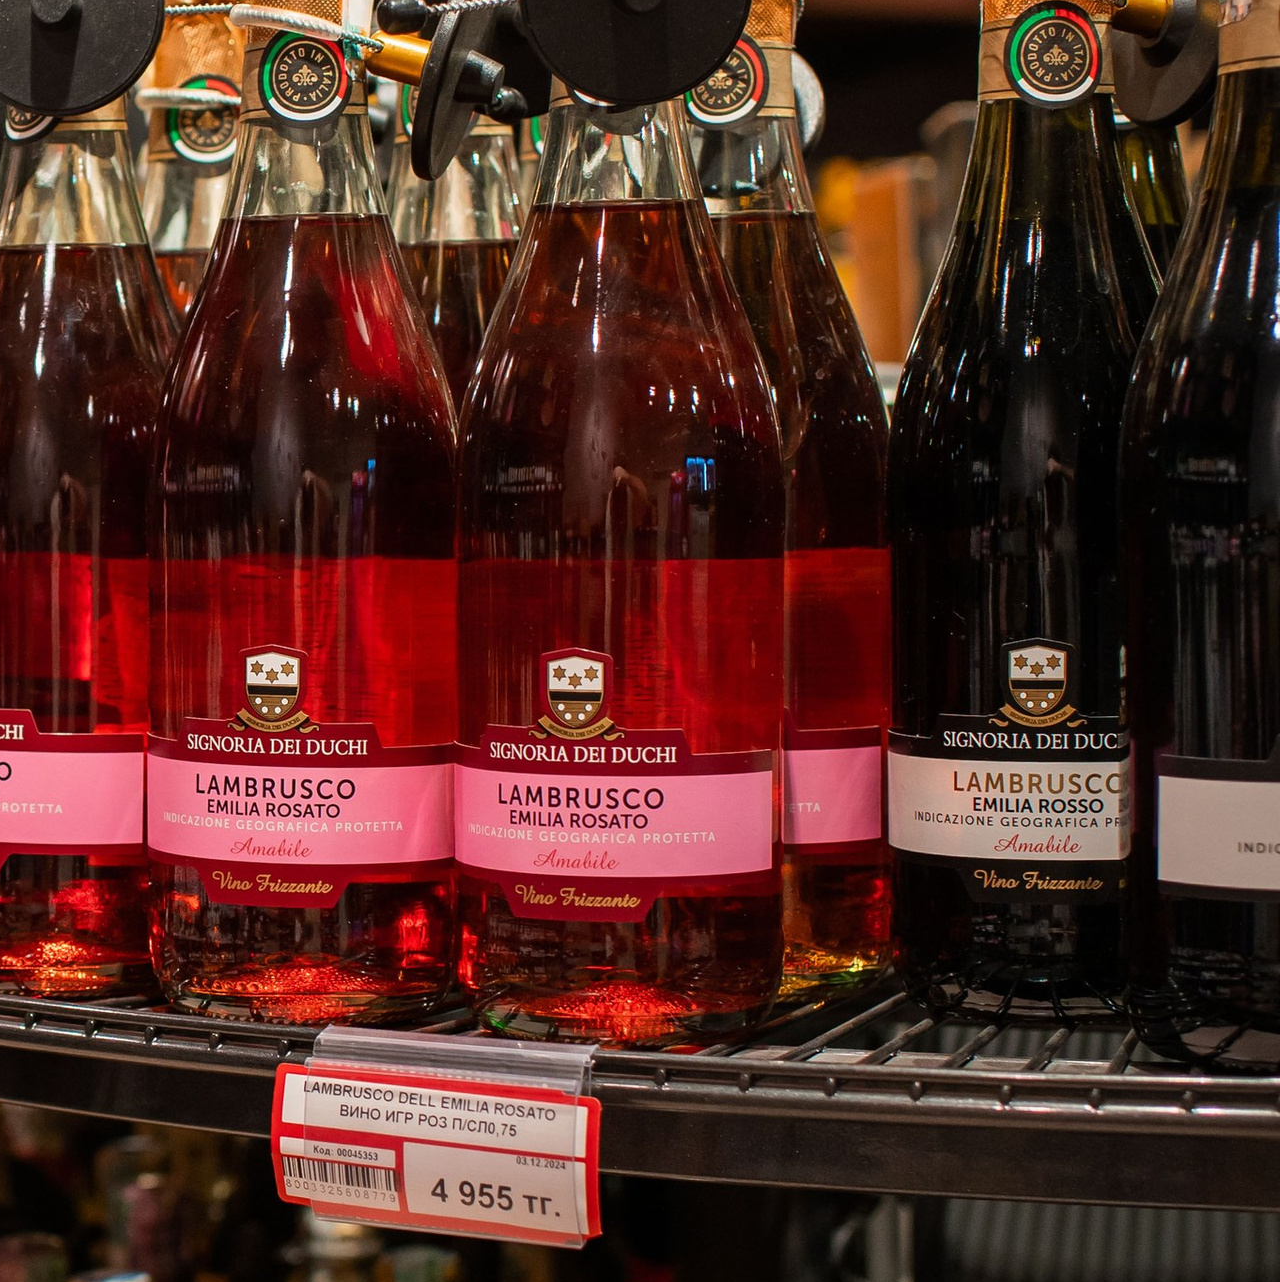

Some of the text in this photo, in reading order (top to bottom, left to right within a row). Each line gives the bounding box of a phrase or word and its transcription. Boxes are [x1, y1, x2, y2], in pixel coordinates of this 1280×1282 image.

[1027, 26, 1084, 82] PRODOTTO IN ITALIA
[278, 47, 333, 102] PRODOTTO IN ITALIA
[187, 733, 368, 756] SIGNORIA DEI DUCHI
[943, 730, 1032, 750] SIGNORIA
[1036, 733, 1069, 750] DEI
[490, 741, 677, 764] SIGNORIA DEI DUCHI
[195, 773, 356, 800] LAMBRUSCO
[498, 782, 665, 810] LAMBRUSCO
[207, 799, 341, 819] EMILIA ROSATO
[972, 797, 1105, 814] EMILIA ROSSO
[162, 811, 404, 833] INDICAZIONE GEOGRAFICA PROTETTA
[509, 809, 649, 830] EMILIA ROSATO
[914, 810, 994, 827] INDICAZIONE
[1000, 817, 1099, 829] GEOGRAFICA
[468, 823, 716, 845] INDICAZIONE GEOGRAFICA PROTETTA
[993, 833, 1082, 854] Amabile
[230, 836, 313, 859] Amabile
[533, 848, 620, 870] Amabile
[212, 870, 334, 895] Vino Frizzante
[973, 869, 1104, 891] Vino Frizzante
[515, 884, 641, 909] Vino Frizzante
[303, 1079, 557, 1122] LAMBRUSCO DELL EMILIA ROSATO
[340, 1103, 381, 1122] ВИНО
[385, 1110, 414, 1126] ИГР
[418, 1113, 448, 1130] РОЗ
[313, 1144, 379, 1162] Код: 00045353
[516, 1154, 566, 1171] 03.12.2024
[285, 1178, 396, 1204] 8003325608779
[431, 1178, 448, 1203] 4
[458, 1180, 514, 1212] 955
